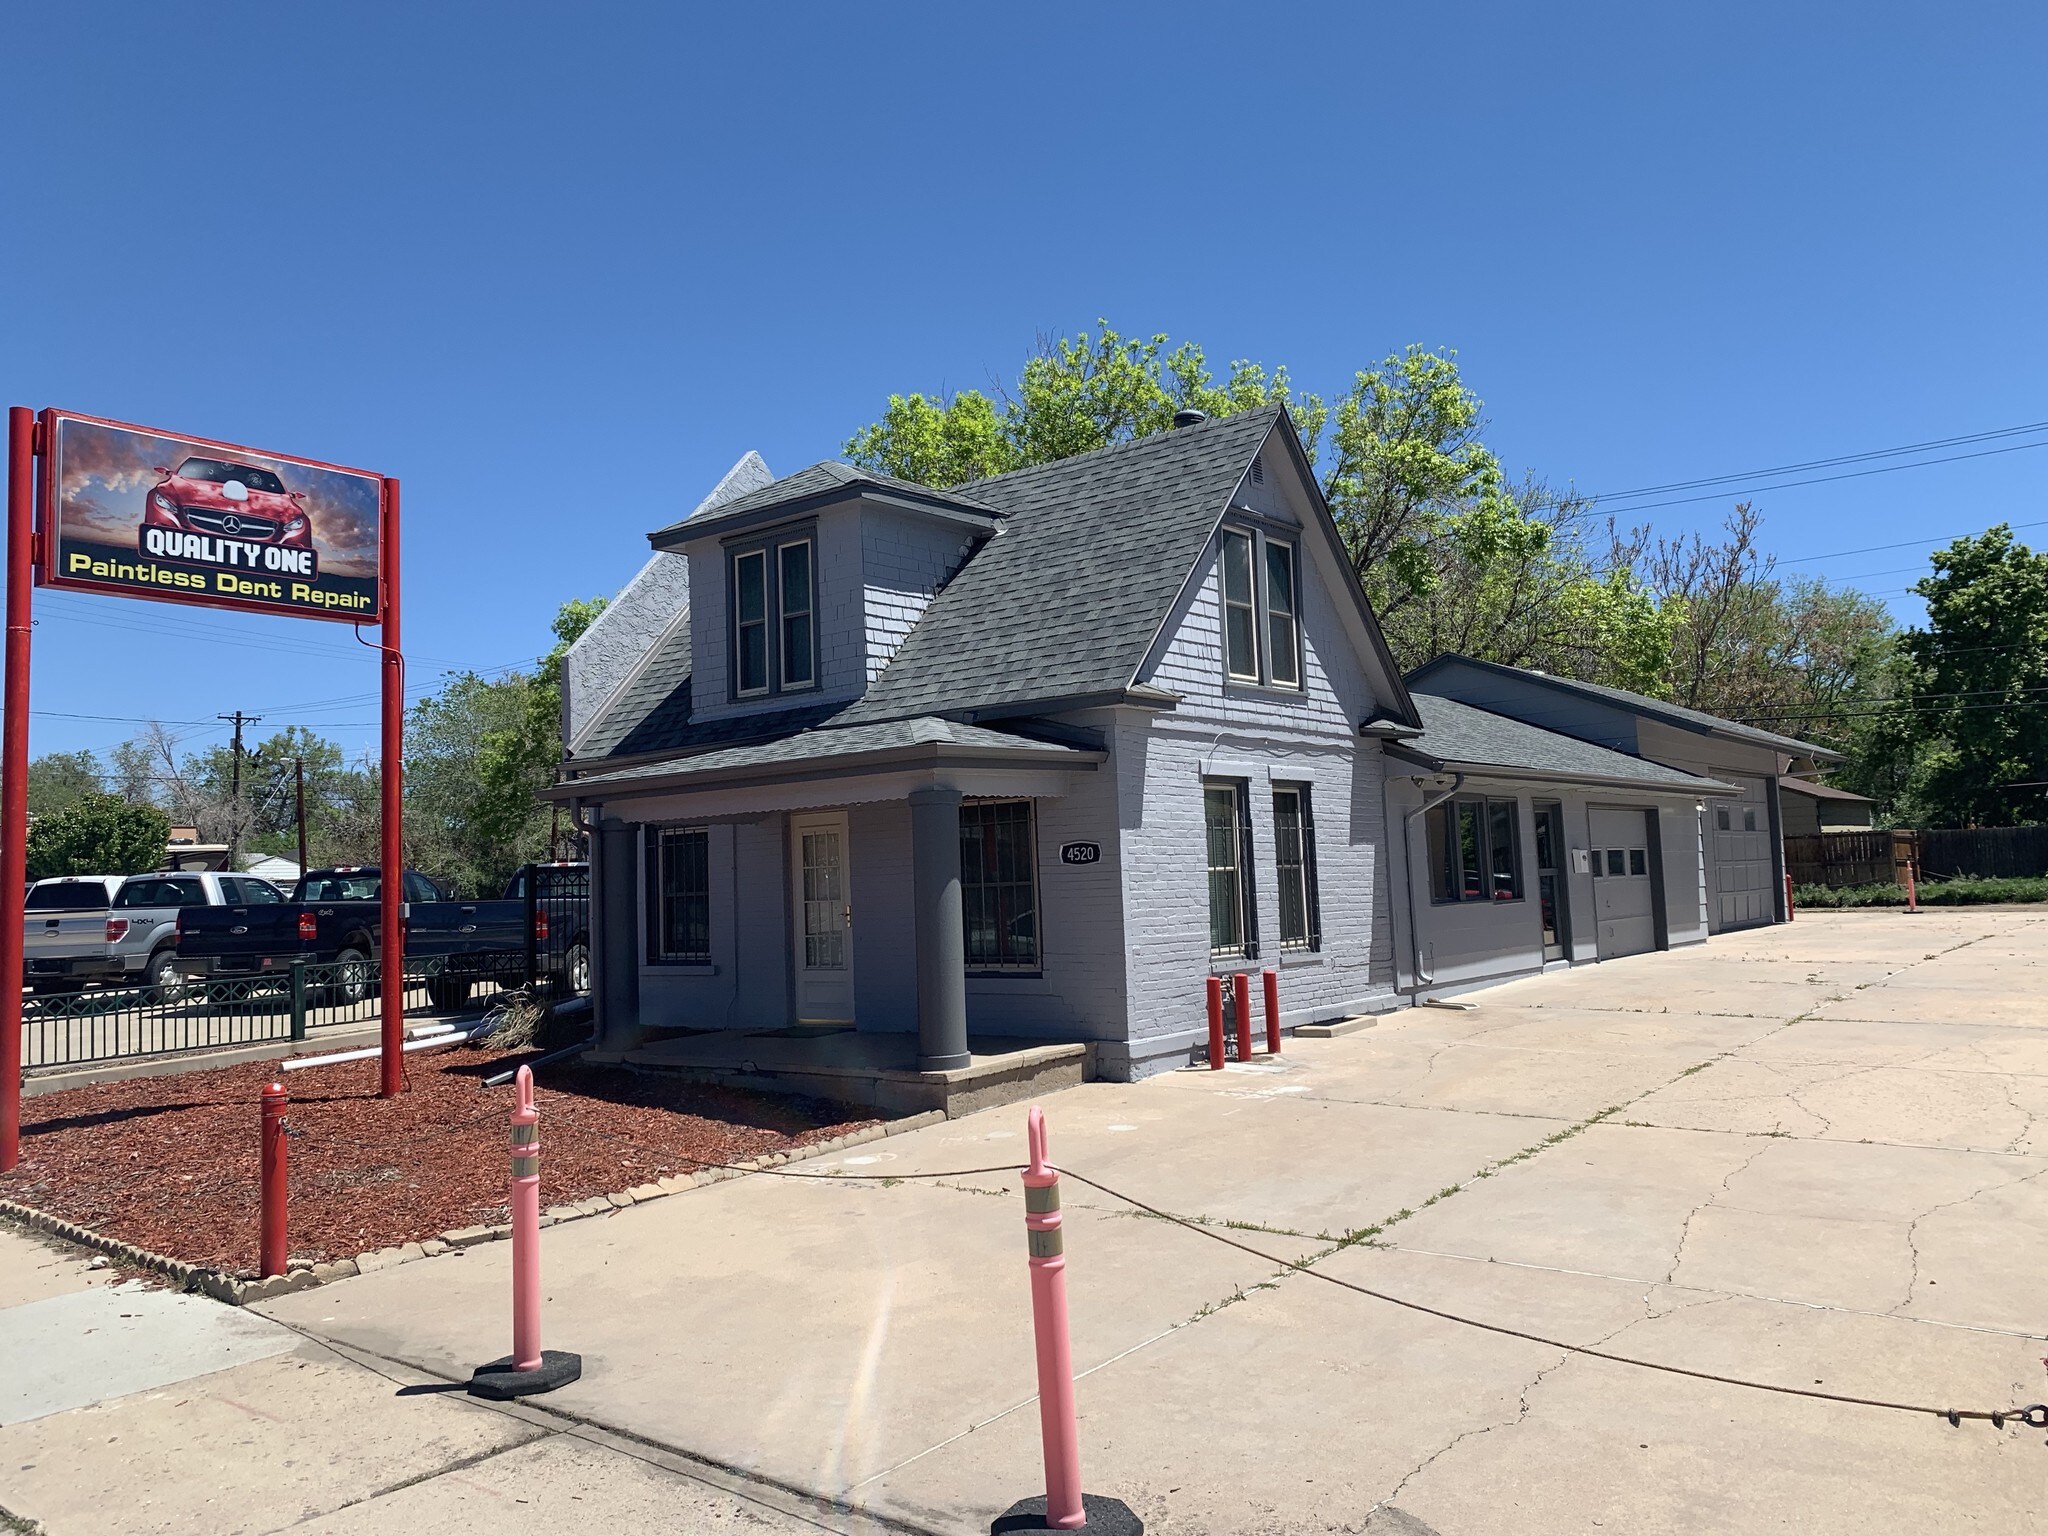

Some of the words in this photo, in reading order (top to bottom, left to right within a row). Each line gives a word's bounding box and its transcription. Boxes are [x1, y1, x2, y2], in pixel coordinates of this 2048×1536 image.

[146, 528, 261, 567] QUALITY
[265, 546, 311, 575] ONE
[70, 553, 206, 588] Paintless
[217, 573, 282, 598] Dent
[292, 582, 371, 608] Repair
[1067, 846, 1094, 861] 4520
